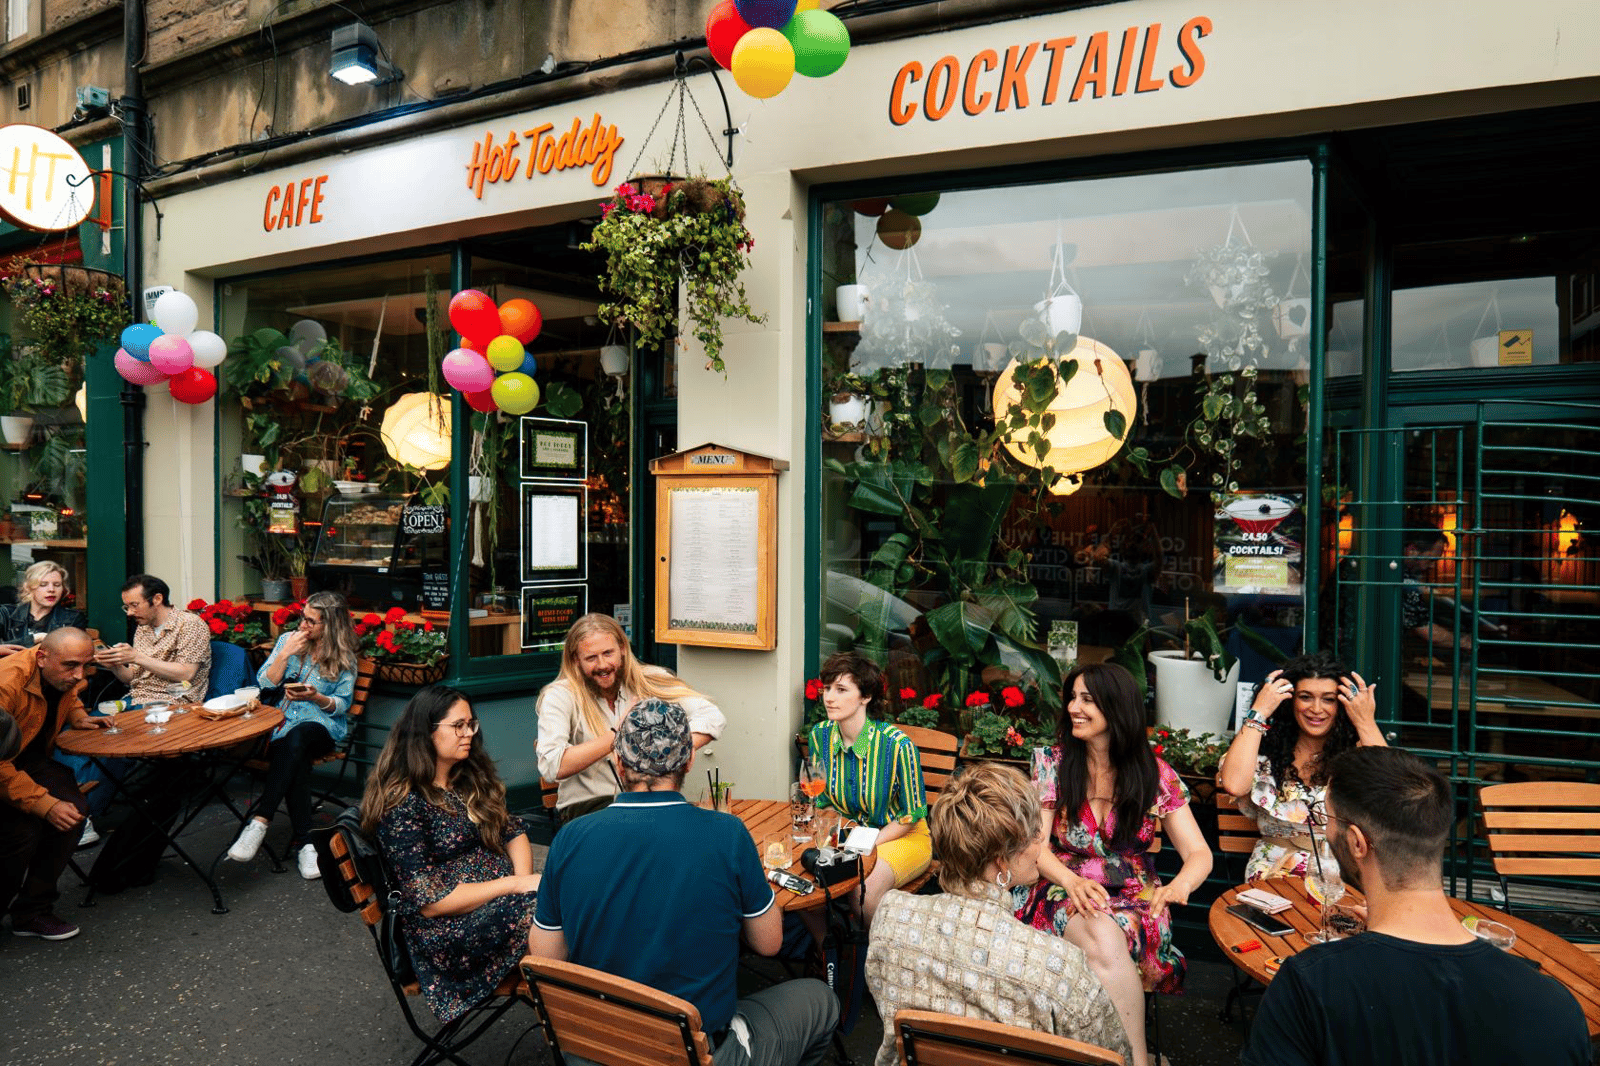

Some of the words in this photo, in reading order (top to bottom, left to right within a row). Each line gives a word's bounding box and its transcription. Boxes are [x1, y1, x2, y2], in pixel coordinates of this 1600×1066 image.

[889, 16, 1213, 126] COCKTAILS
[465, 130, 521, 200] Hot
[523, 112, 624, 187] Toddy
[2, 143, 74, 210] HT
[263, 174, 331, 233] CAFE
[697, 455, 728, 464] MENU
[408, 514, 439, 527] OPEN
[1241, 532, 1268, 541] £4.50
[1229, 546, 1283, 555] COCKTAILS!
